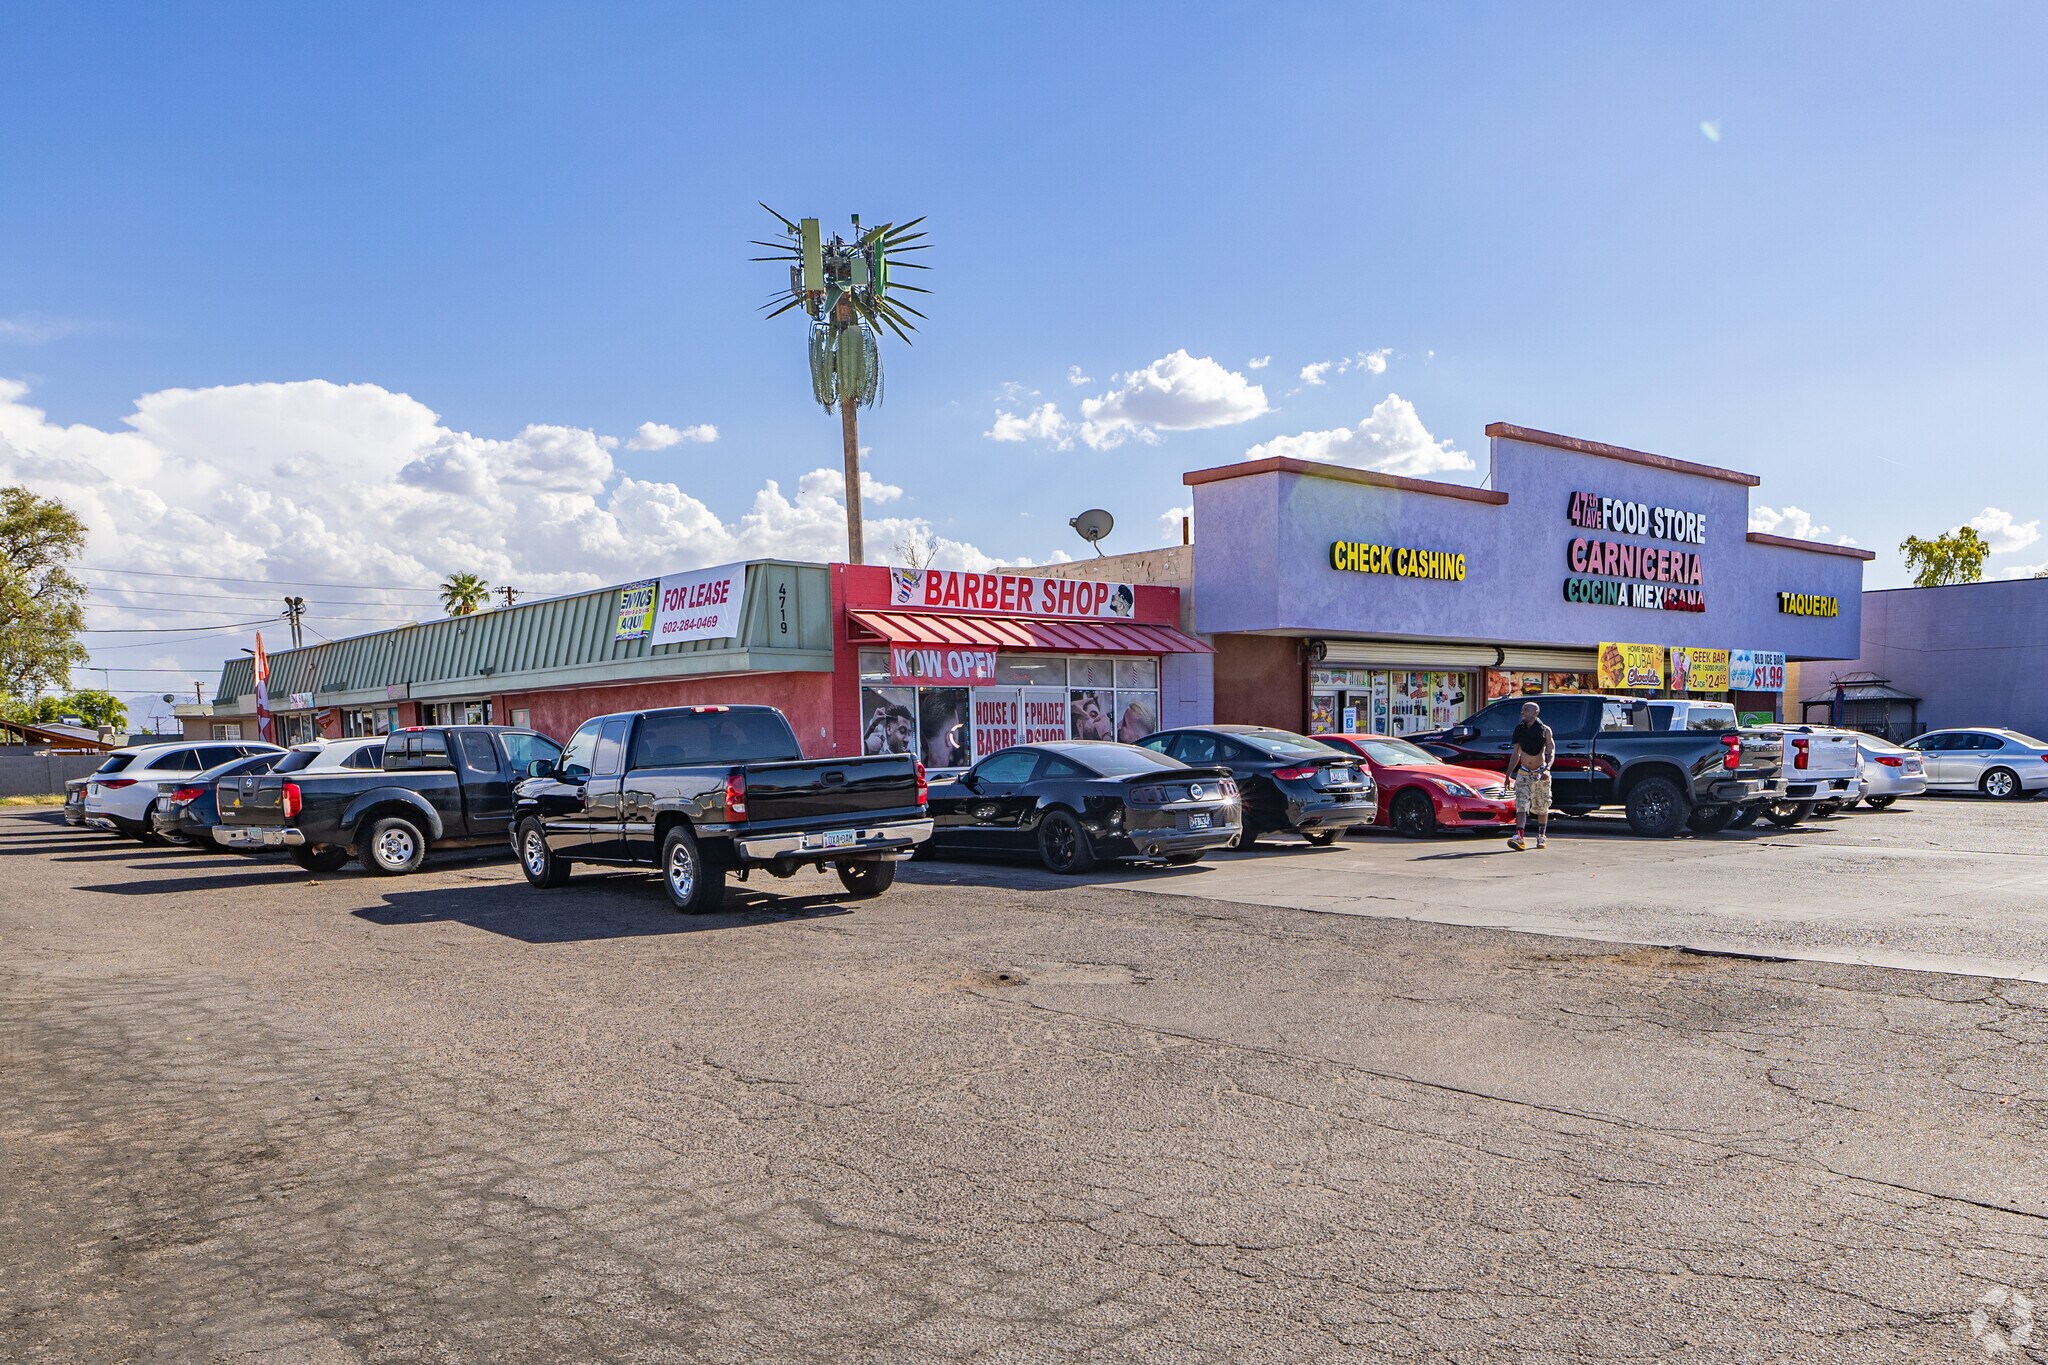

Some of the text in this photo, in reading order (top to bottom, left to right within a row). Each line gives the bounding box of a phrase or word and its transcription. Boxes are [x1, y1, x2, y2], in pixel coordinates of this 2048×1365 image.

[1586, 512, 1602, 529] AVE
[1602, 498, 1649, 535] FOOD
[1653, 507, 1706, 545] STORE
[1333, 540, 1467, 581] CHECK CASHING
[1571, 537, 1704, 586] CARNICERIA
[621, 588, 653, 610] ENVIOS
[662, 580, 731, 613] FOR LEASE
[924, 569, 1109, 615] BARBER SHOP
[1567, 577, 1706, 613] COCINA MEXICANA
[1781, 591, 1839, 617] TAQUERIA
[778, 582, 788, 634] 4719
[662, 615, 718, 634] 602-284-0469
[1628, 645, 1641, 653] HOME
[1628, 653, 1655, 669] DUBAI
[1692, 651, 1726, 664] GEEK BAR
[1764, 654, 1773, 665] ICE
[1773, 654, 1783, 666] BAG
[893, 648, 997, 679] NOW OPEN
[1692, 664, 1702, 672] VAPE
[1754, 666, 1784, 689] $1.99
[975, 701, 1008, 726] HOUSE
[1030, 702, 1066, 726] PHADEZ
